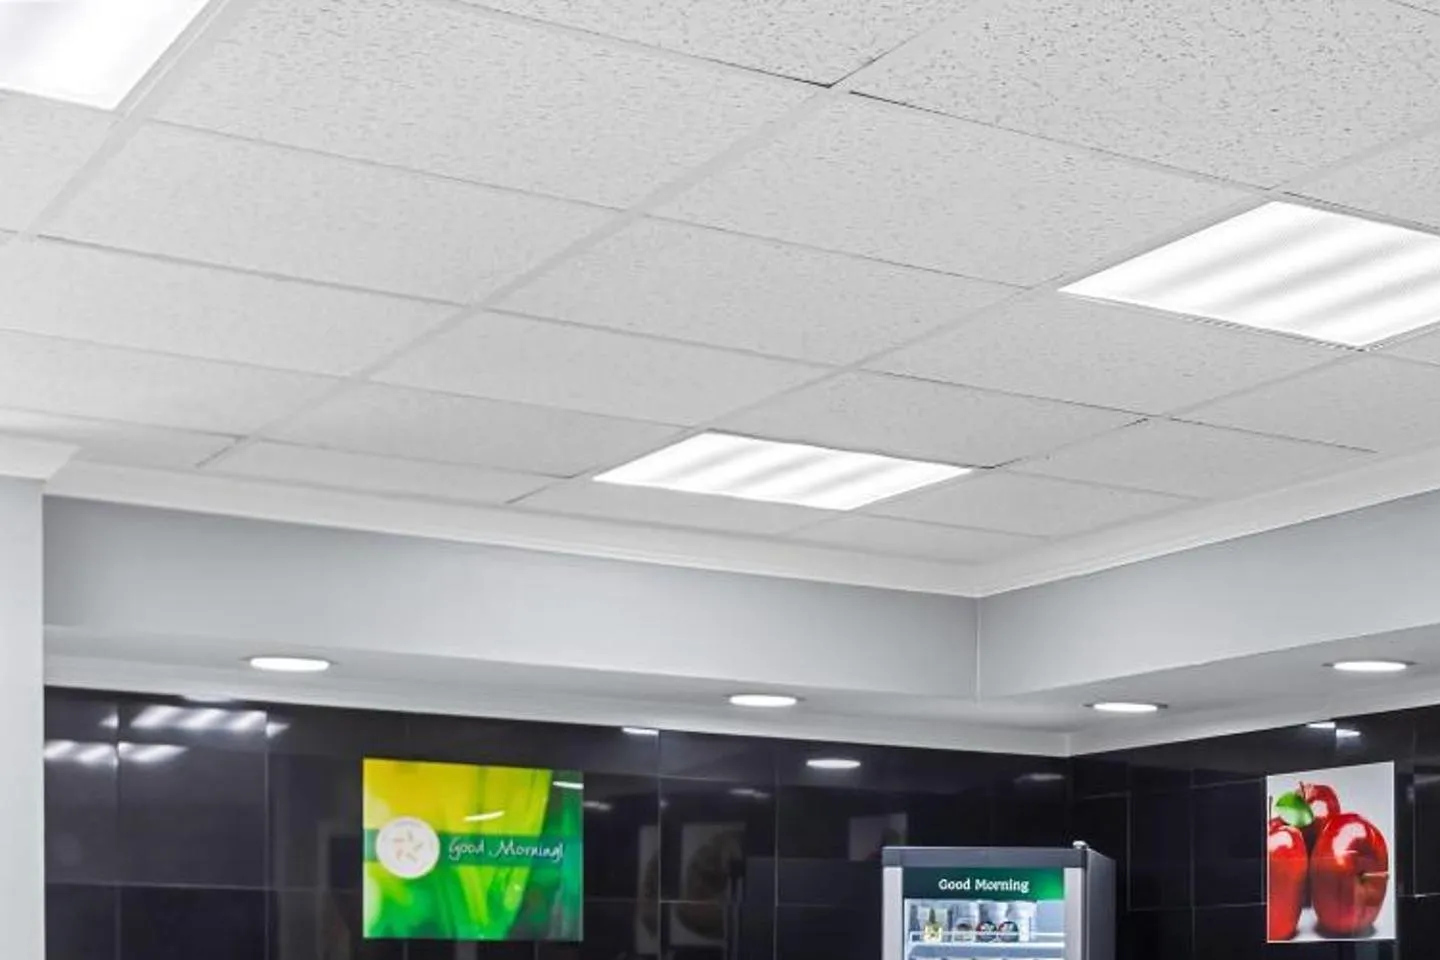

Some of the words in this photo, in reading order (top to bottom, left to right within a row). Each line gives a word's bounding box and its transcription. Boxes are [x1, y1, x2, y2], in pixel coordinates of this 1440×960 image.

[448, 837, 485, 861] Good
[938, 878, 971, 891] Good
[974, 878, 1030, 894] Morning
